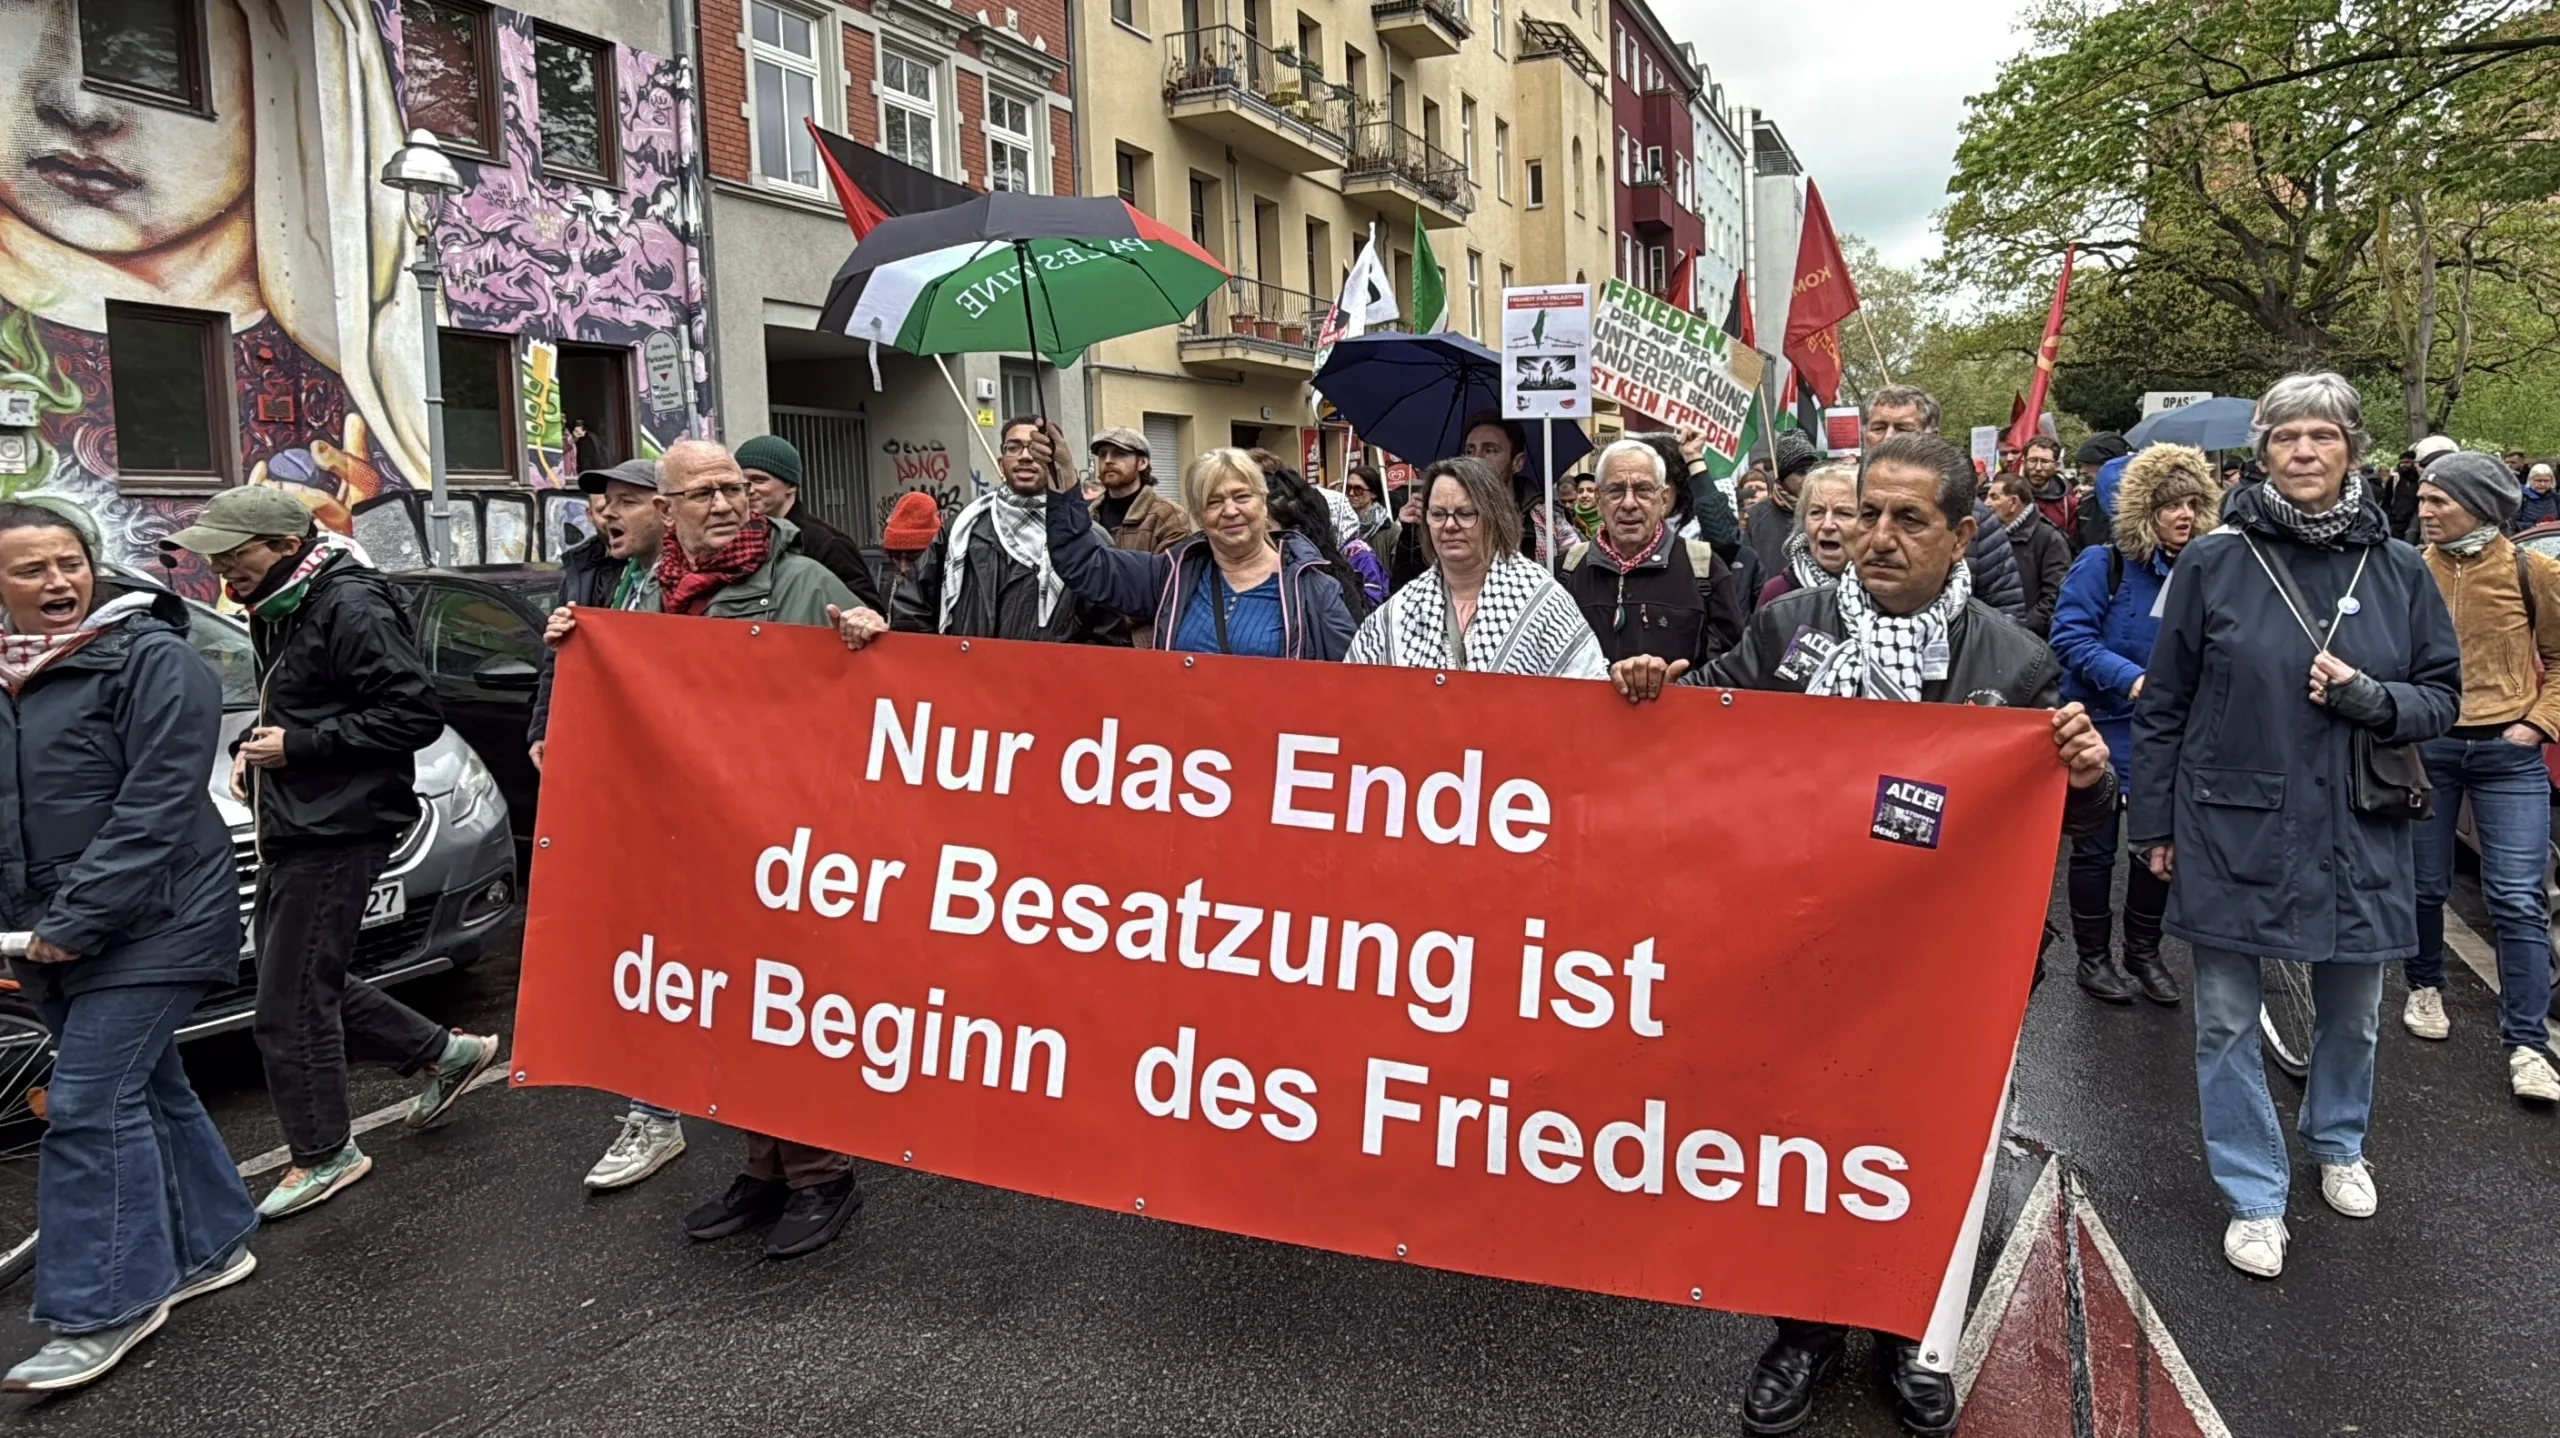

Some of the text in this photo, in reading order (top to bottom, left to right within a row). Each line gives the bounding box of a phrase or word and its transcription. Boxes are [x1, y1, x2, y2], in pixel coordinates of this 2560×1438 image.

[1606, 278, 1728, 362] FRIEDEN,
[1609, 307, 1711, 365] DER AUF DER
[1591, 342, 1742, 433] ANDERER BERUHT
[1591, 366, 1739, 458] ST KEIN FRIEDEN
[1593, 317, 1751, 418] UNTERDRÜCKUNG
[865, 698, 1552, 855] Nur das Ende
[1872, 825, 1900, 840] DEMO
[365, 885, 399, 919] 27
[755, 827, 1667, 1038] der Besatzung ist
[613, 934, 1912, 1222] der Beginn des Friedens
